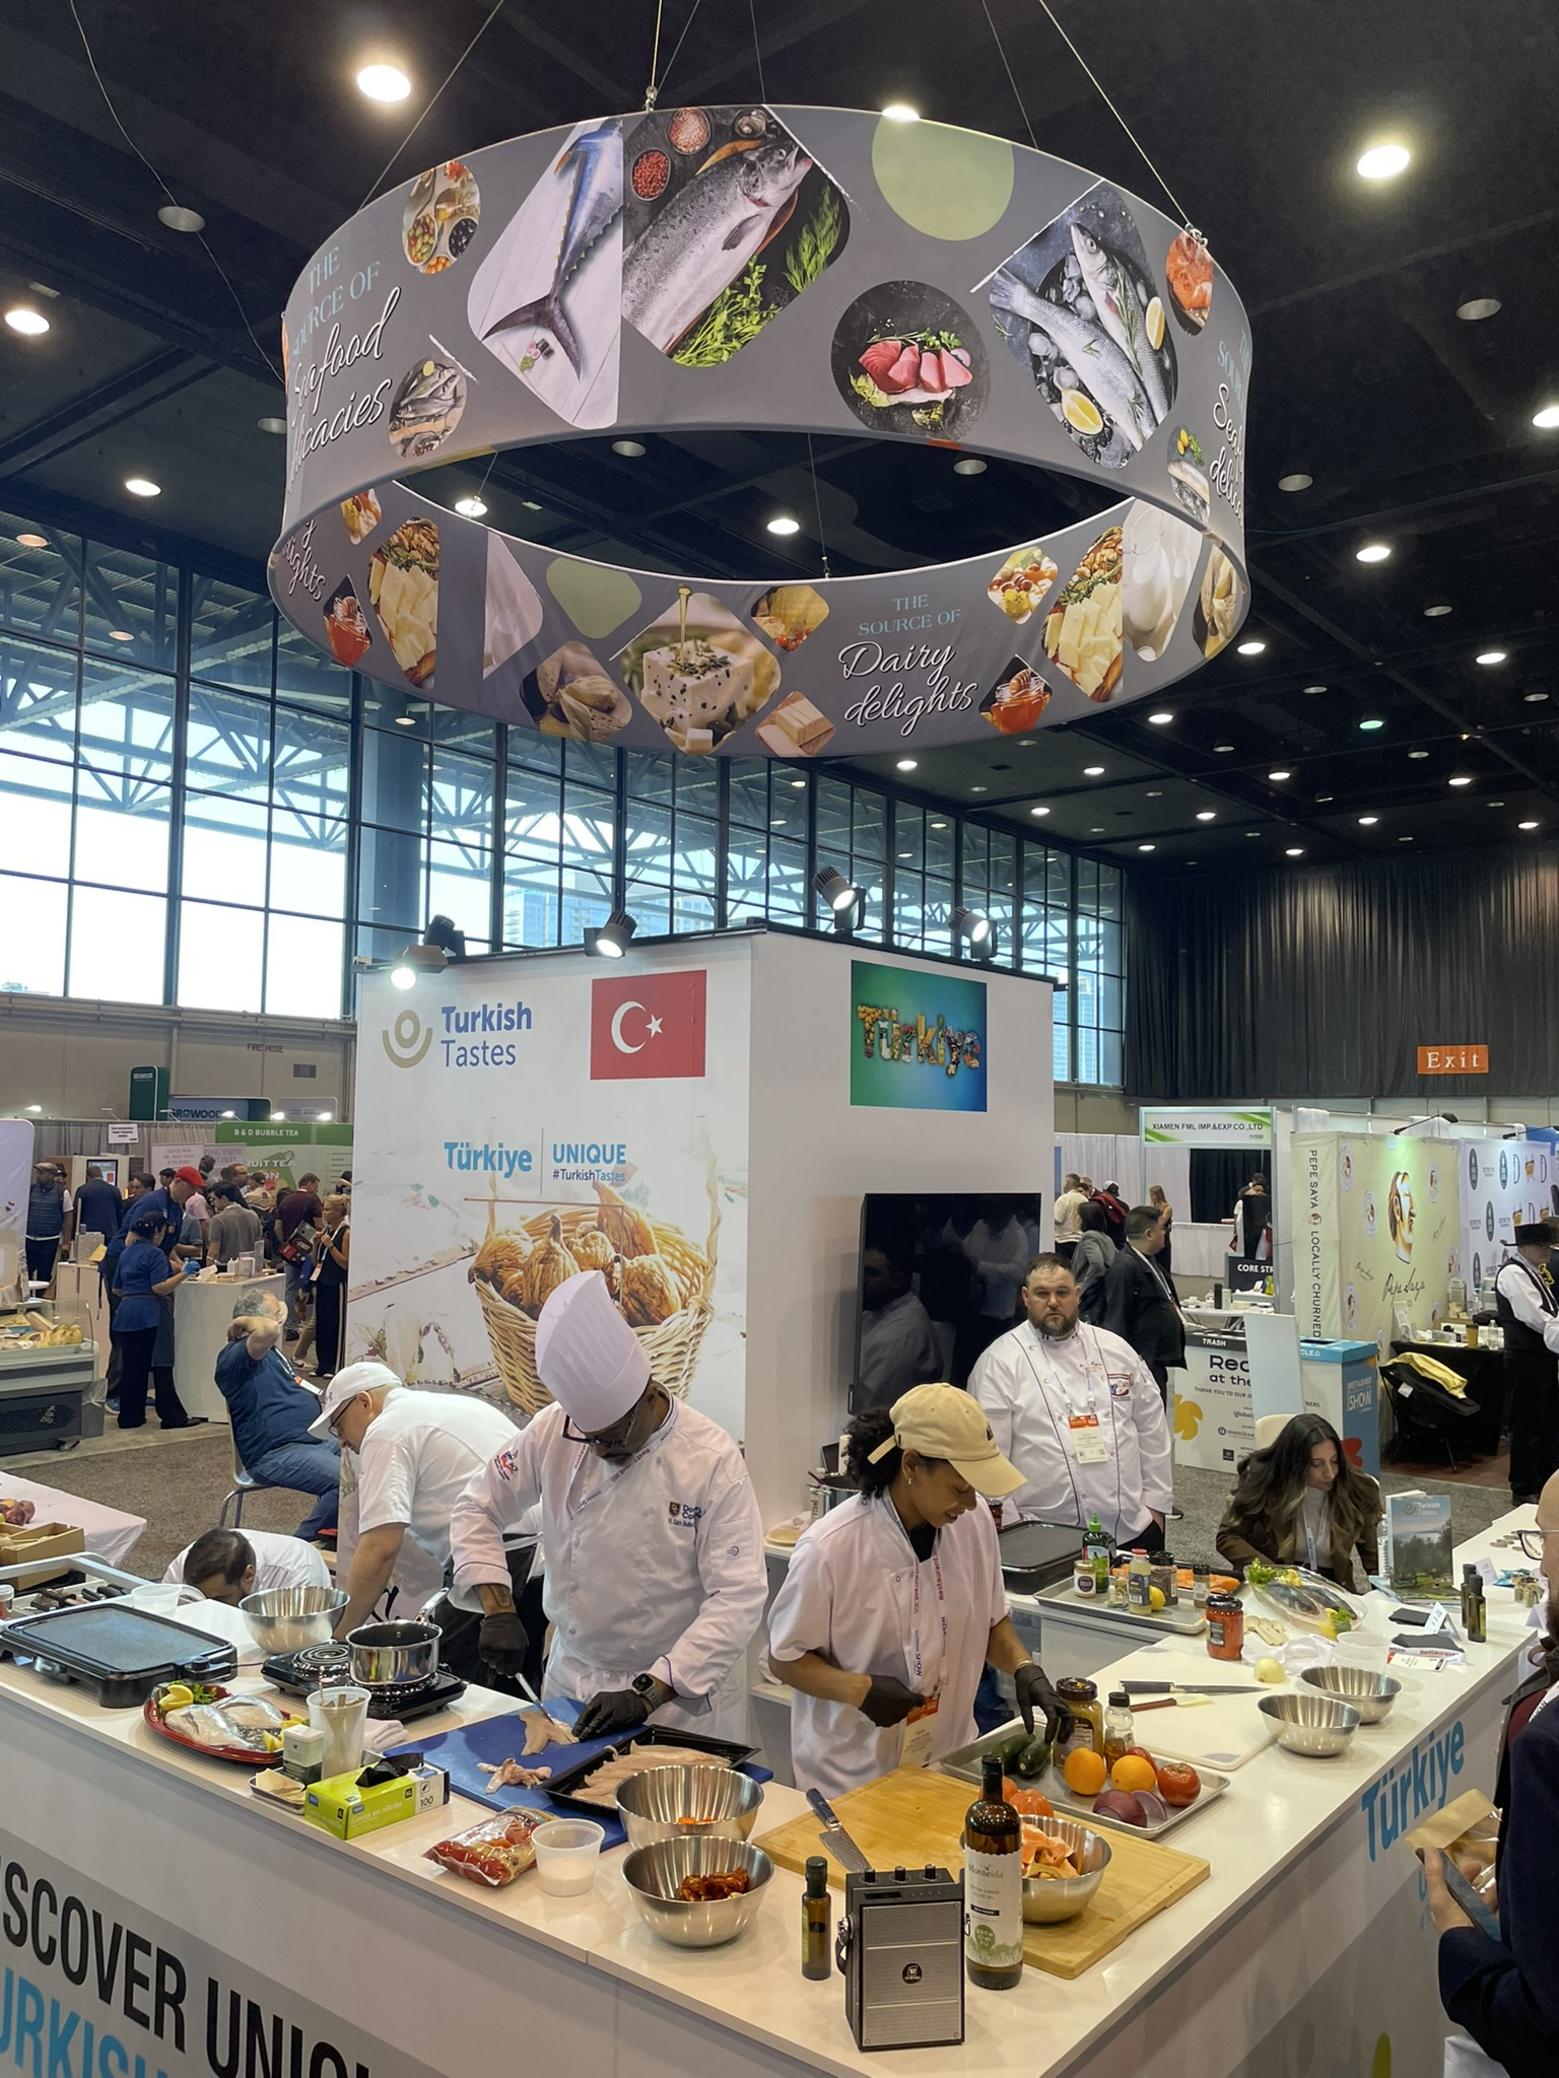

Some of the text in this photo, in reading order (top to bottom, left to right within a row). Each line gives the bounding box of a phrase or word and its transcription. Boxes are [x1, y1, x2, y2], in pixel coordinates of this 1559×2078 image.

[307, 246, 340, 294] THE
[350, 261, 382, 300] OF
[892, 594, 929, 611] THE
[858, 608, 961, 637] SOURCE OF
[838, 641, 954, 686] Dairy
[844, 675, 979, 736] delights
[441, 1001, 532, 1034] Turkish
[441, 1039, 516, 1068] Tastes
[1426, 1051, 1480, 1069] Exit
[234, 1129, 299, 1137] B & D BUBBLE TEA
[1152, 1123, 1180, 1131] XIAMEN
[444, 1141, 533, 1179] Türkiye
[552, 1143, 626, 1165] UNIQUE
[272, 1160, 297, 1169] TEA
[552, 1168, 626, 1183] #TurkishTastes
[1309, 1150, 1322, 1338] PEPE SAYA LOCALLY CHURNED
[1237, 1264, 1259, 1272] CORE
[1202, 1338, 1226, 1347] TRASH
[1209, 1373, 1225, 1383] at
[1194, 1386, 1212, 1394] THANK
[1213, 1388, 1225, 1396] YOU
[1348, 1390, 1372, 1409] SHOW
[1361, 1720, 1465, 1862] Türkiye
[420, 1796, 434, 1807] 100
[0, 1856, 187, 2054] SCOVER
